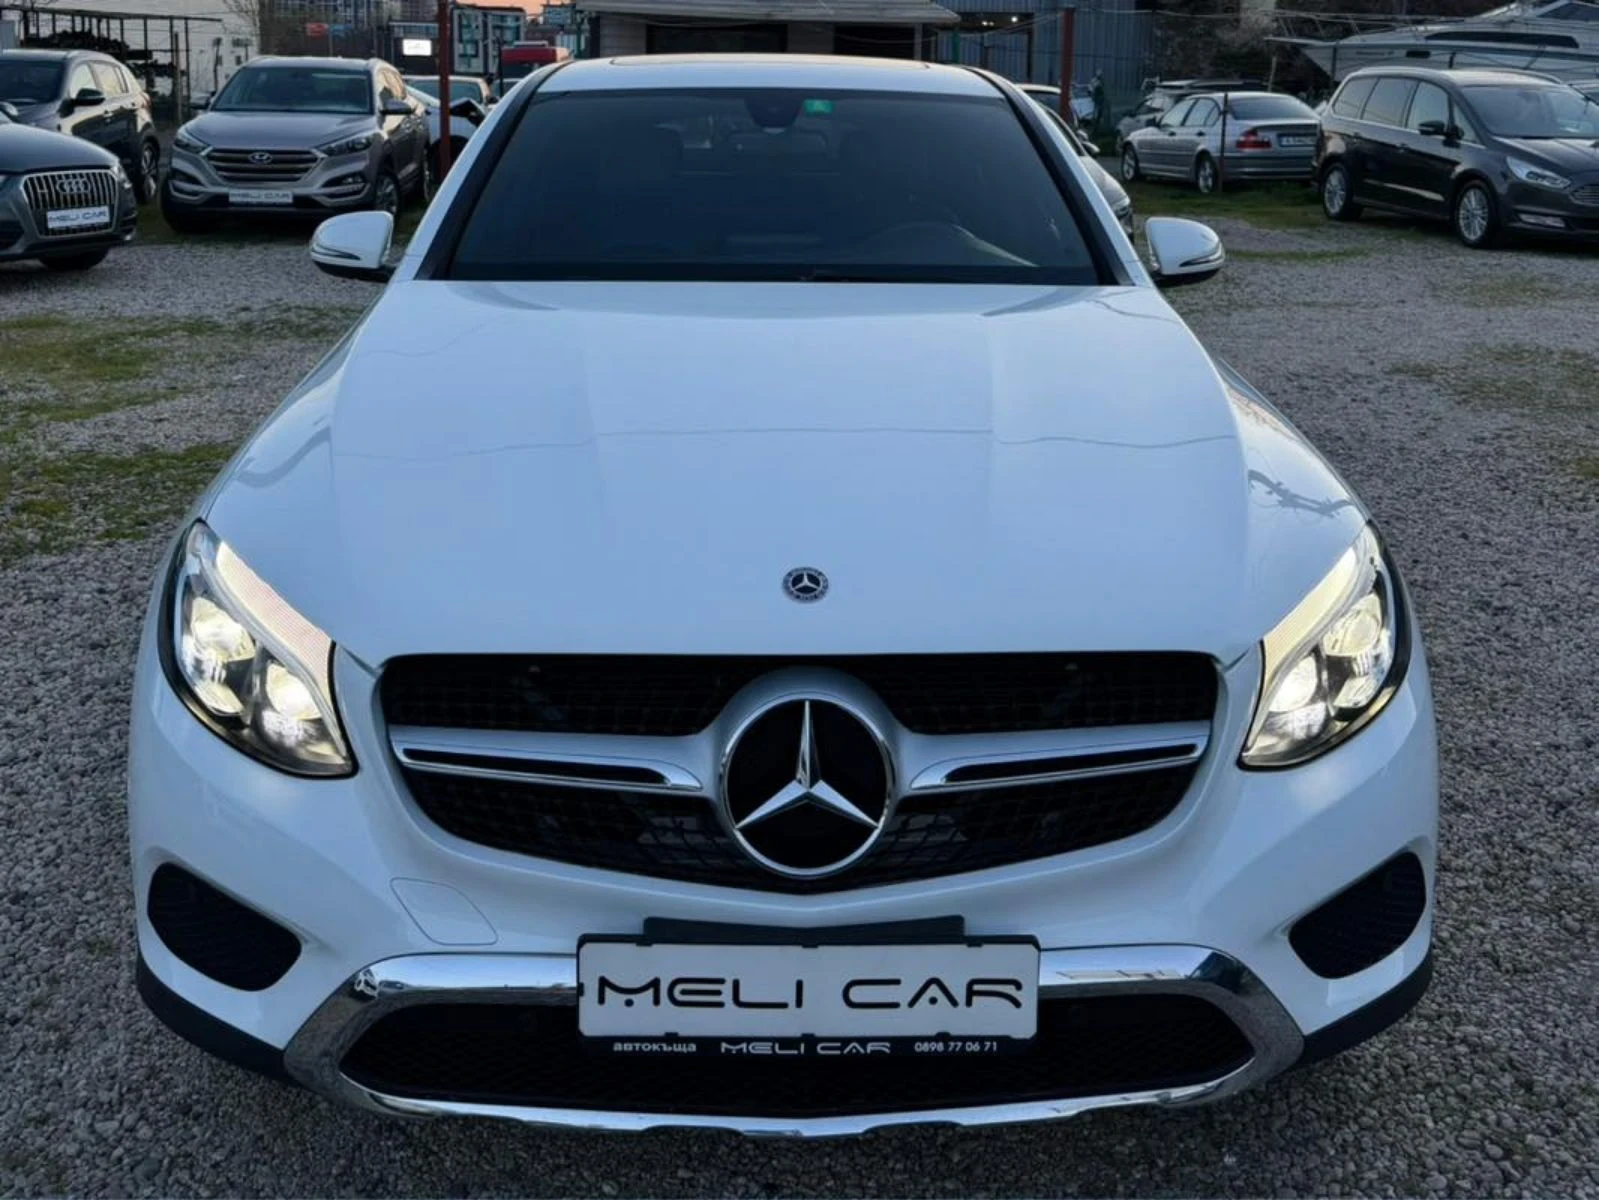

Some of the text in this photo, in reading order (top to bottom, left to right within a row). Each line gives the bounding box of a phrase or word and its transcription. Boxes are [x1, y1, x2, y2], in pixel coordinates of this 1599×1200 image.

[597, 975, 1023, 1010] MELI CAR
[613, 1041, 997, 1055] автокъща MELI CAR 0898 77 06 71
